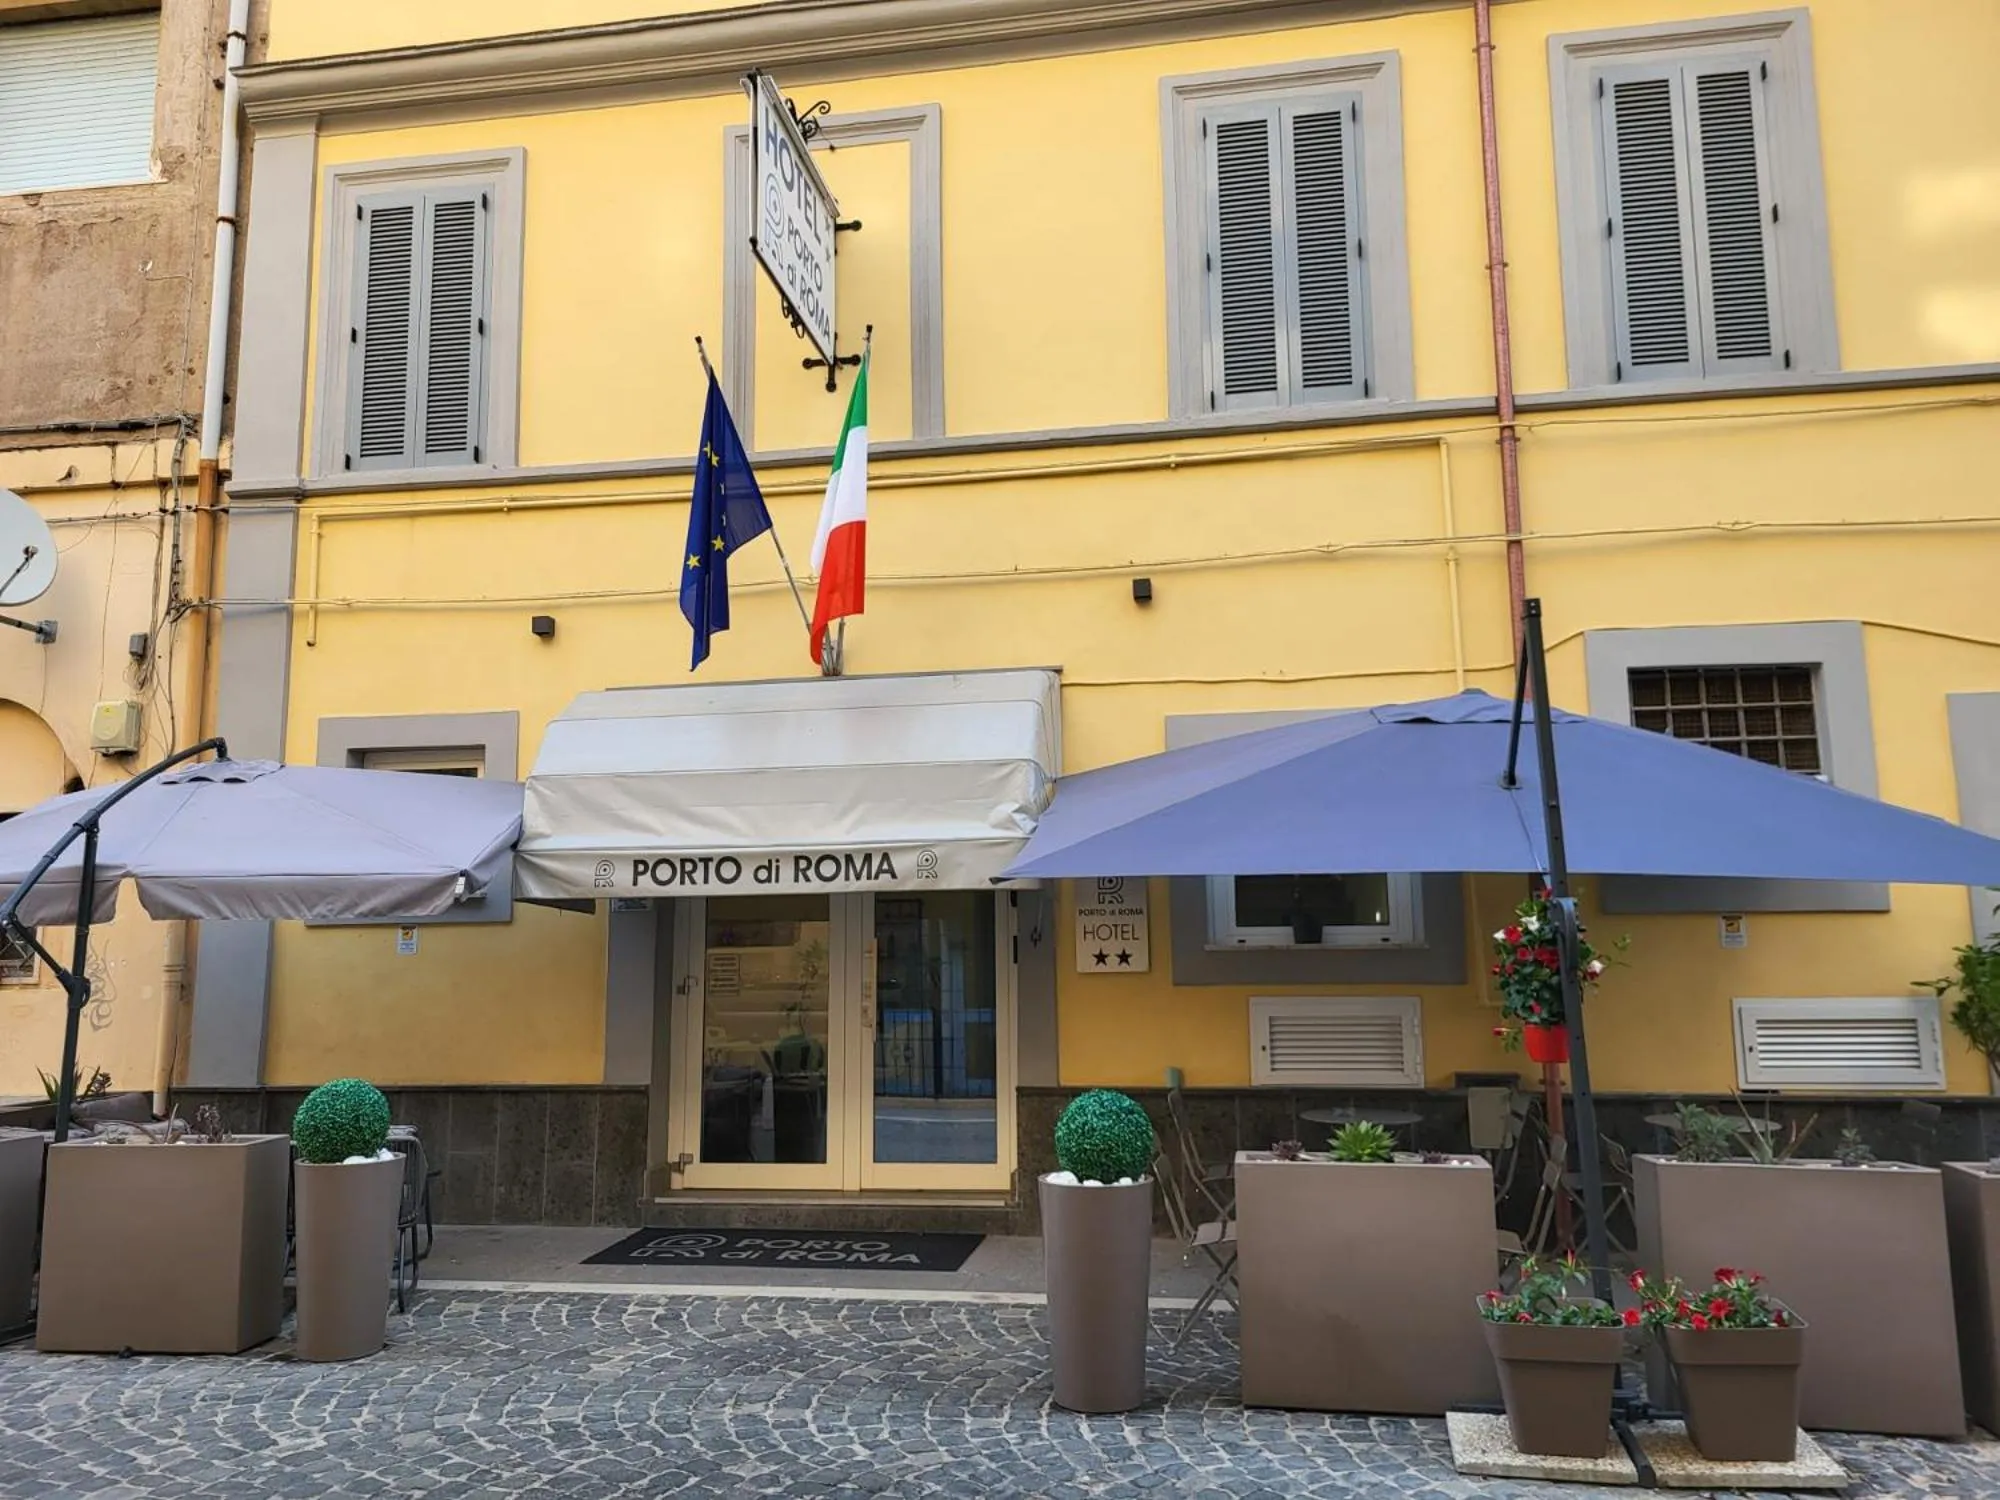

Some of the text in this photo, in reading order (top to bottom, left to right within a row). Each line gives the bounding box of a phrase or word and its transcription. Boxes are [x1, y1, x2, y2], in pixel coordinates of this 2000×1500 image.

[765, 106, 822, 246] HOTEL
[787, 215, 824, 293] PORTO
[787, 263, 831, 344] di ROMA
[632, 855, 743, 886] PORTO
[753, 858, 780, 884] di
[793, 851, 898, 884] ROMA
[1083, 923, 1140, 942] HOTEL
[720, 1250, 922, 1265] di ROMA
[735, 1238, 891, 1252] PORTO
